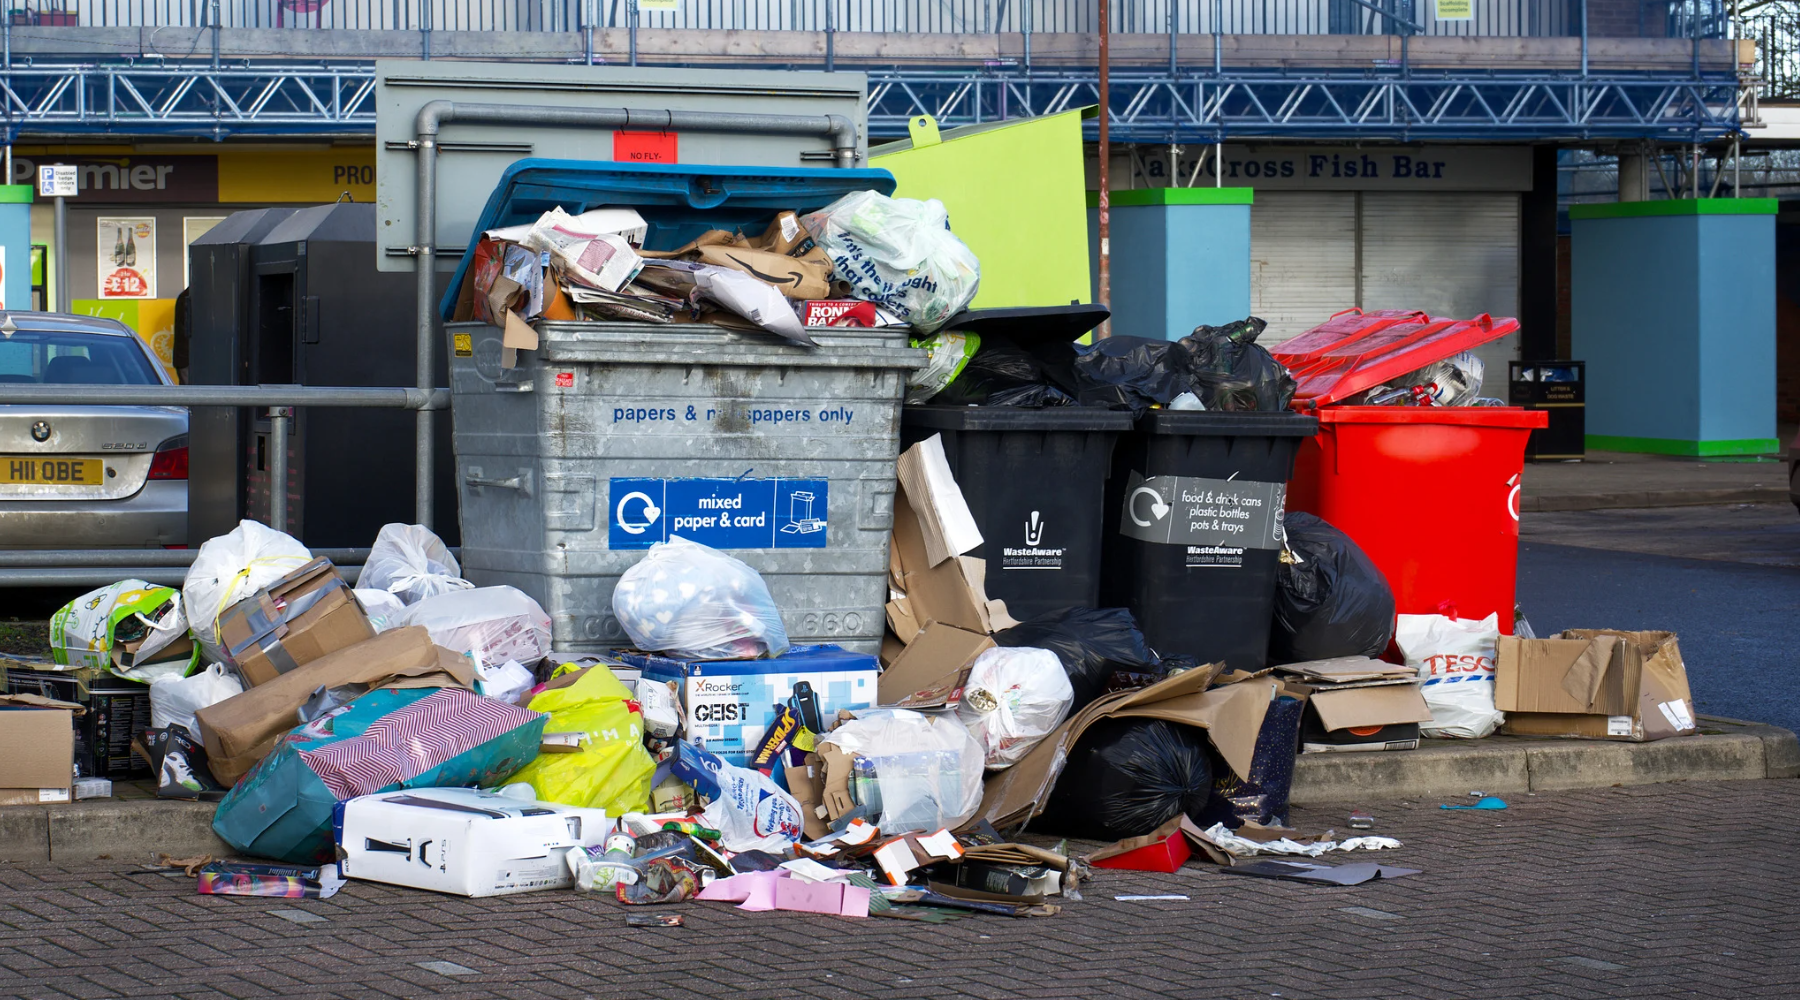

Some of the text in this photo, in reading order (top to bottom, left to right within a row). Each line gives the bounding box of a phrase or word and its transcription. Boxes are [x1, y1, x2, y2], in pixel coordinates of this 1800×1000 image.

[630, 152, 662, 160] NO FLY-
[12, 158, 174, 190] Pmier
[334, 165, 376, 185] PRO
[1308, 154, 1378, 178] Fish
[1393, 154, 1447, 178] Bar
[835, 255, 863, 285] that
[860, 261, 882, 286] the
[111, 277, 141, 292] £12
[613, 407, 676, 423] papers
[685, 405, 698, 421] &
[819, 407, 854, 425] only
[698, 493, 742, 509] mixed
[1181, 490, 1205, 503] food
[1205, 490, 1213, 503] &
[1240, 498, 1262, 507] cans
[674, 511, 765, 531] paper & card
[1189, 505, 1250, 520] plastic bottles
[1190, 519, 1244, 535] pots & trays
[1003, 547, 1063, 556] WasteAware
[1186, 546, 1244, 555] WasteAware
[1186, 555, 1242, 564] Hertfordshire Partnership
[1002, 557, 1061, 566] Hertfordshire Partnership
[802, 611, 863, 636] 660
[1423, 654, 1495, 675] TESC
[694, 702, 750, 722] GEIST
[630, 723, 641, 737] A
[754, 706, 796, 765] SPIDER-MAN
